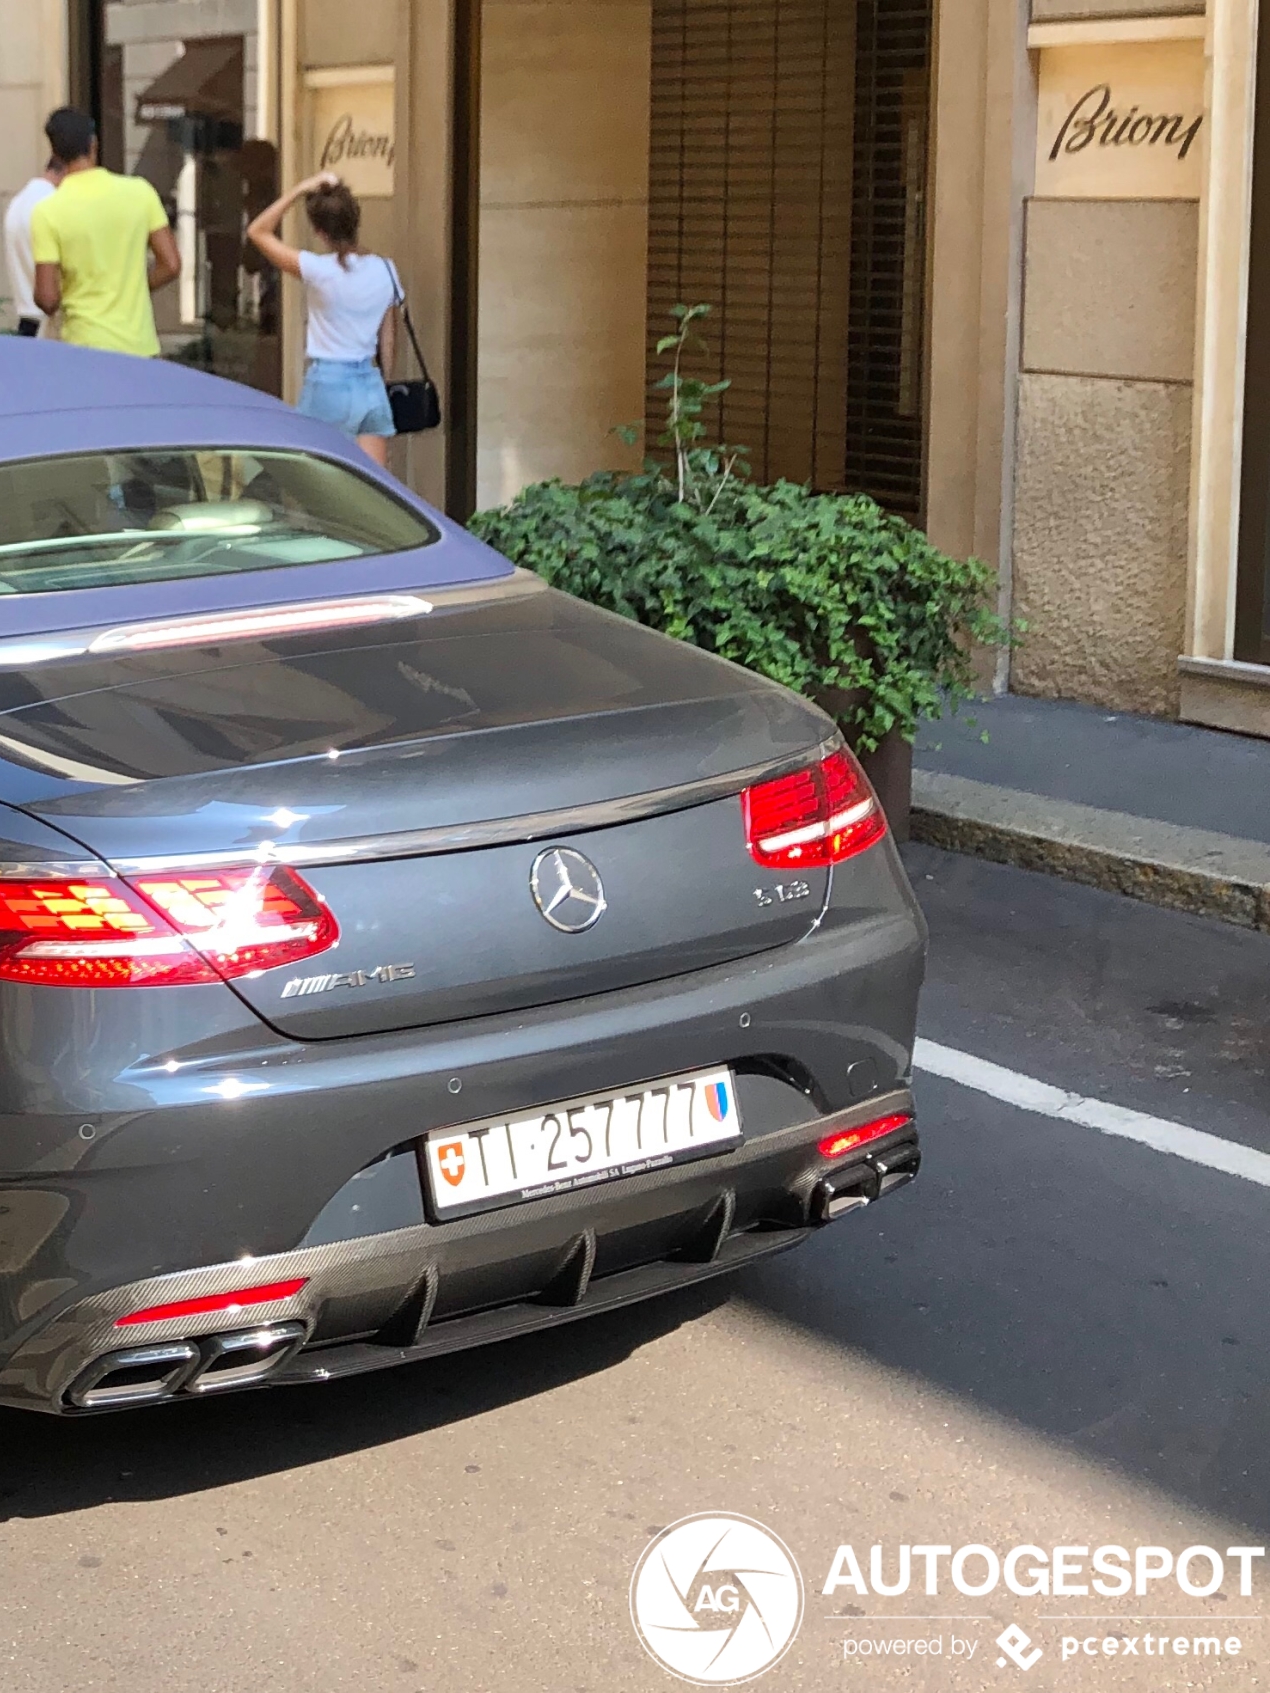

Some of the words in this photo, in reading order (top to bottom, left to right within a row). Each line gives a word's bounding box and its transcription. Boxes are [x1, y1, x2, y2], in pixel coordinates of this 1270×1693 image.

[327, 962, 417, 991] AMG
[521, 1180, 572, 1199] Mercedes-Benz
[609, 1167, 620, 1178] SA
